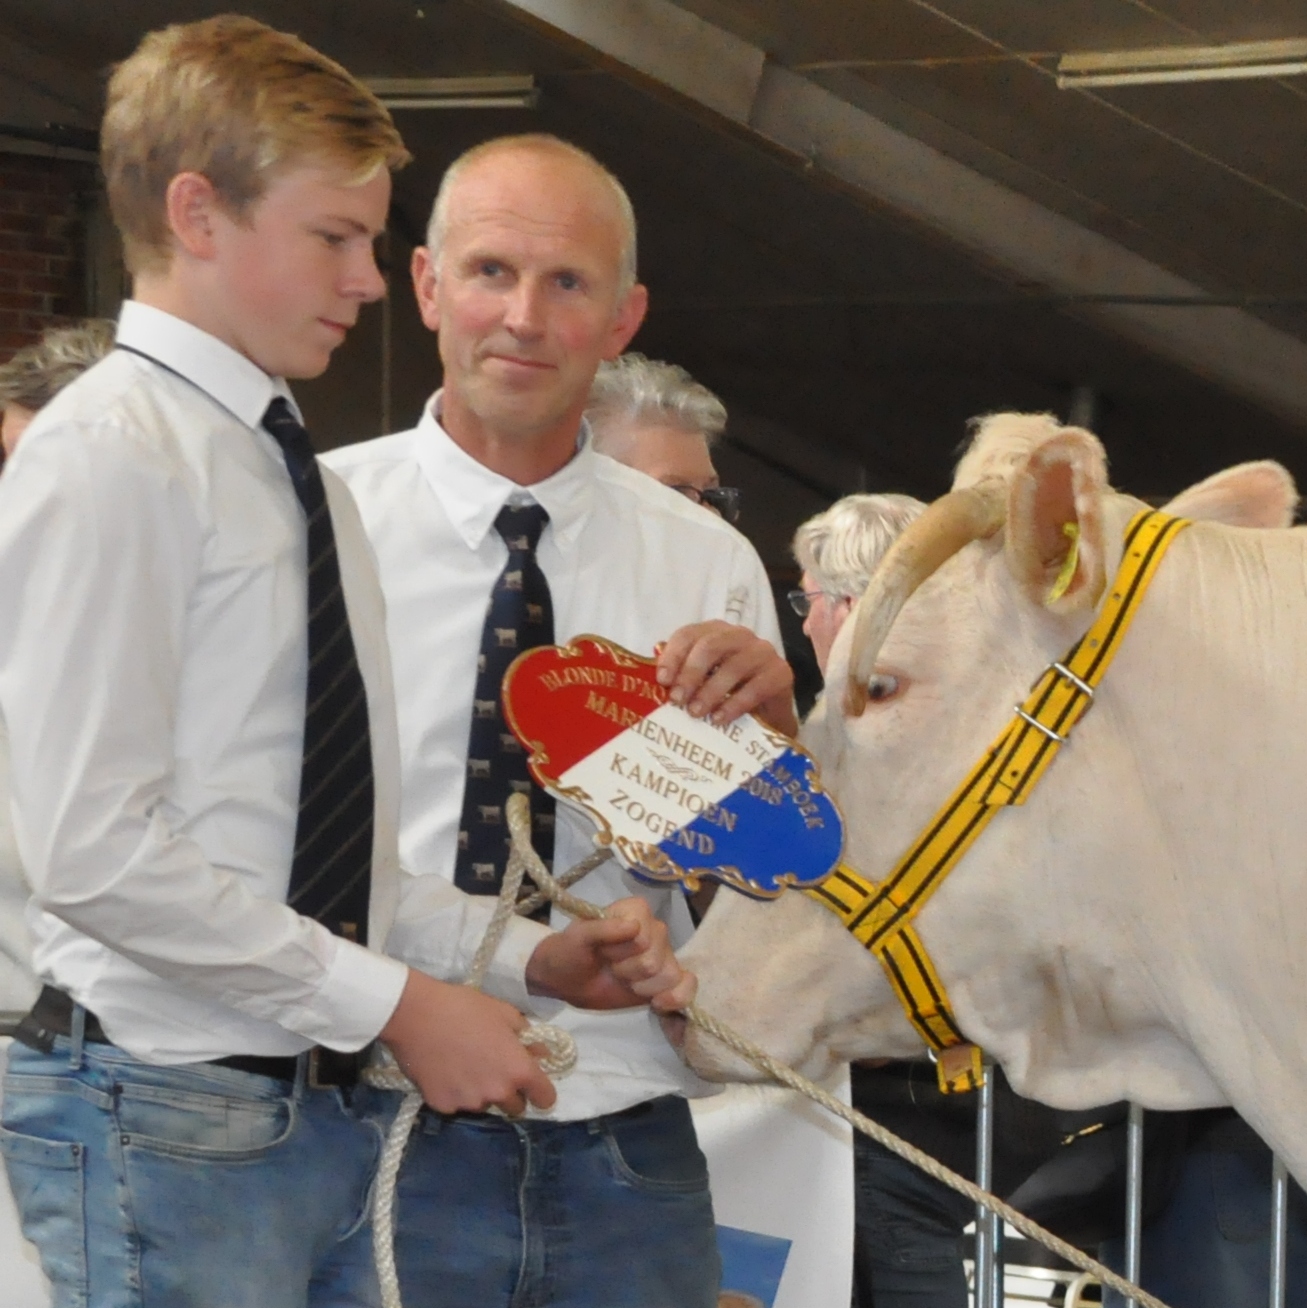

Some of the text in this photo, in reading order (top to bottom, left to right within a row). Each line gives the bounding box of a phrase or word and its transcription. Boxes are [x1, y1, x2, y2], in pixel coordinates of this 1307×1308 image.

[539, 666, 617, 692] BLONDE
[745, 740, 825, 830] STAMBOEK
[584, 690, 785, 807] MARIENHEEM 2018
[610, 752, 738, 832] KAMPIOEN
[609, 789, 716, 856] ZOGEND
